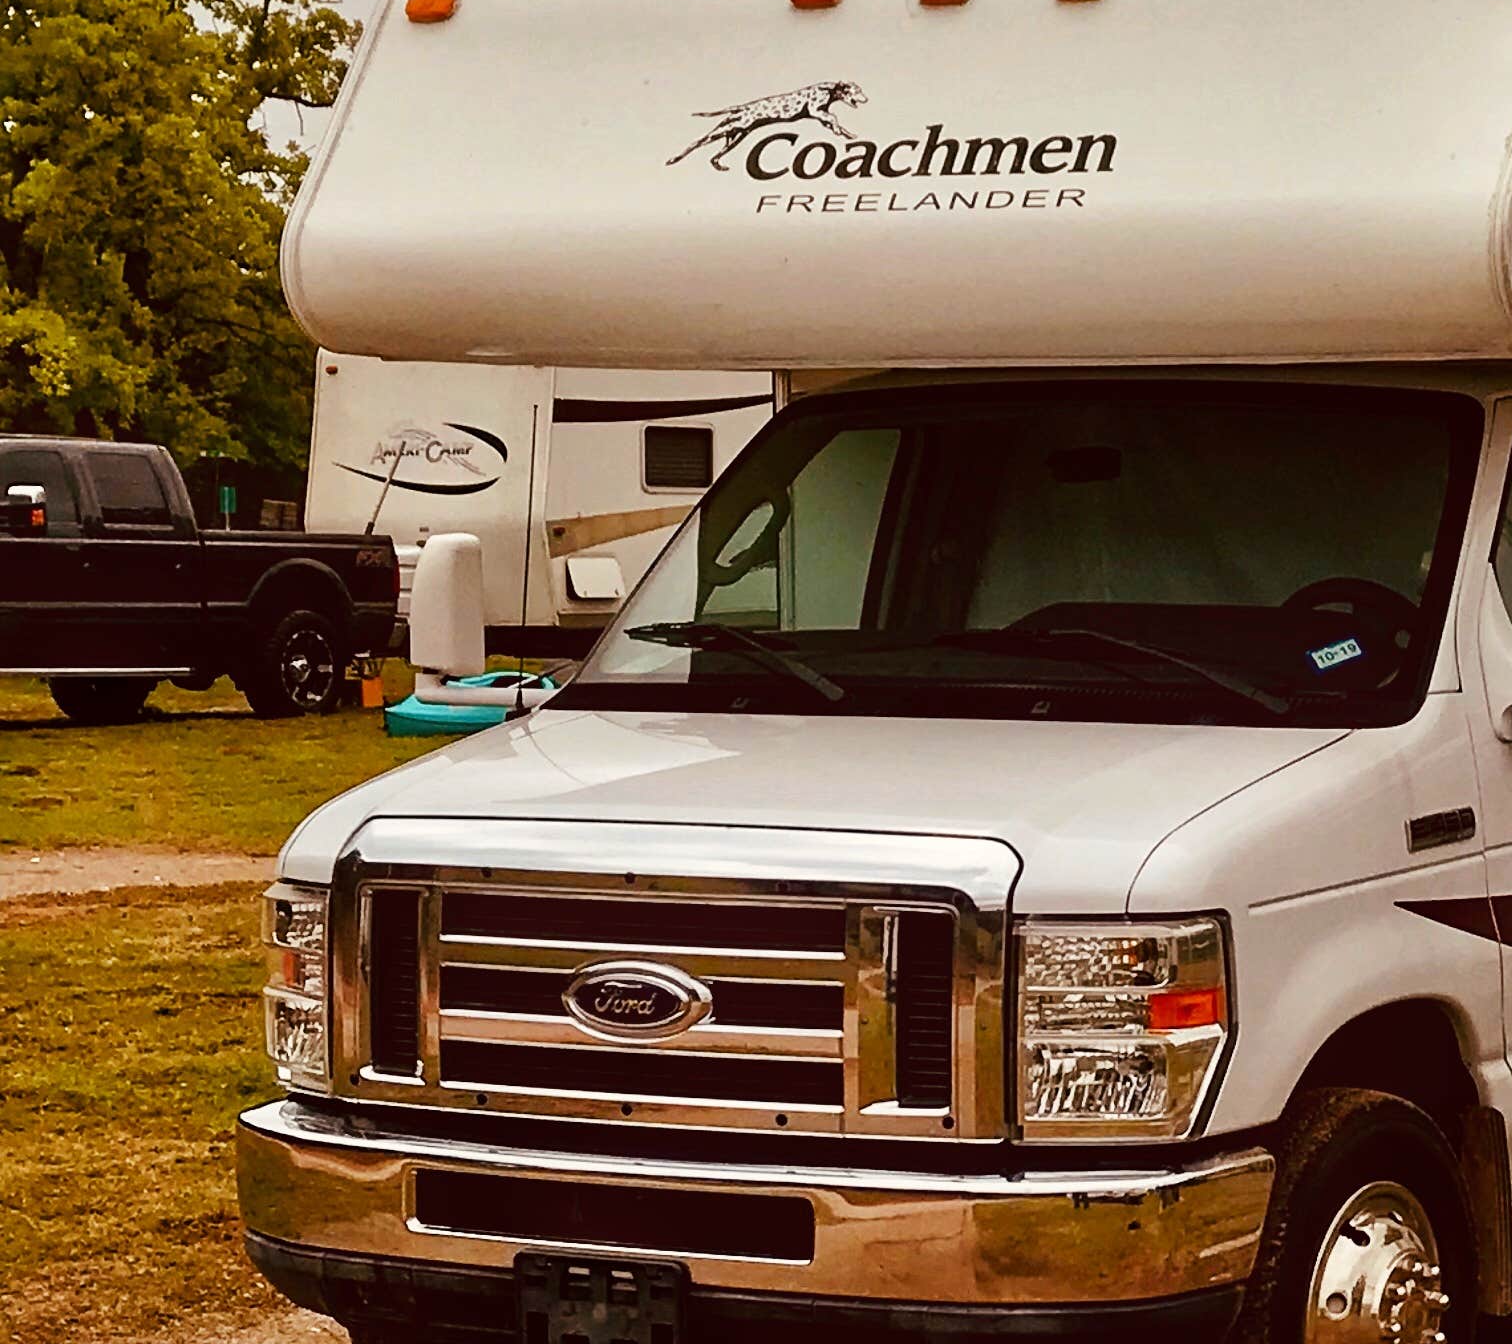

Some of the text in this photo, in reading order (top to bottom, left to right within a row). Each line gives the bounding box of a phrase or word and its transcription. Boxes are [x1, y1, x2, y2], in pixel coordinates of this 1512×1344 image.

[746, 124, 1118, 181] Coachmen
[755, 188, 1087, 214] FREELANDER
[1317, 642, 1357, 664] 10-19
[594, 981, 657, 1015] Ford
